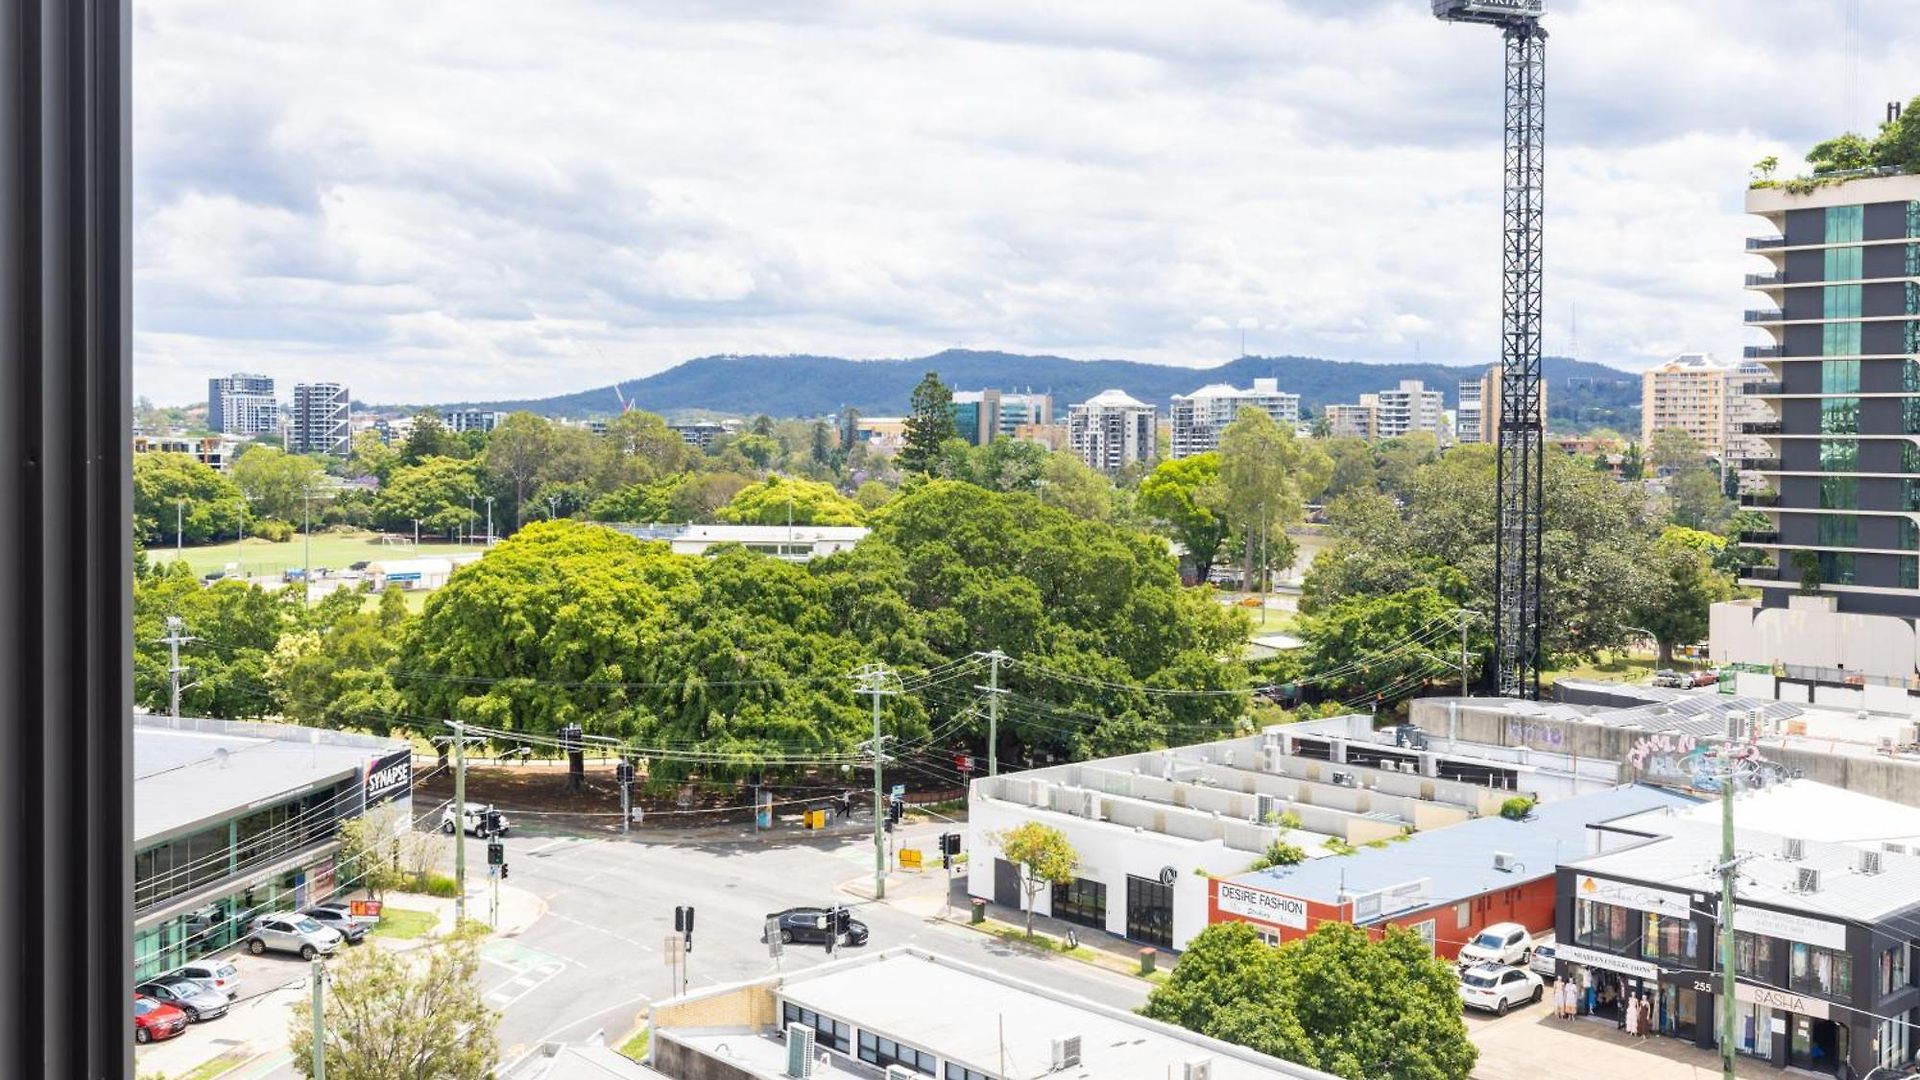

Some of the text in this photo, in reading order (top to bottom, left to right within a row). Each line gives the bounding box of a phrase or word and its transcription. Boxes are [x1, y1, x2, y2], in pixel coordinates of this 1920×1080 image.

[369, 763, 408, 792] SYNAPSE
[1221, 886, 1257, 904] DESIRE
[1259, 895, 1304, 916] FASHION
[1693, 980, 1712, 993] 255
[1753, 988, 1805, 1012] SASHA
